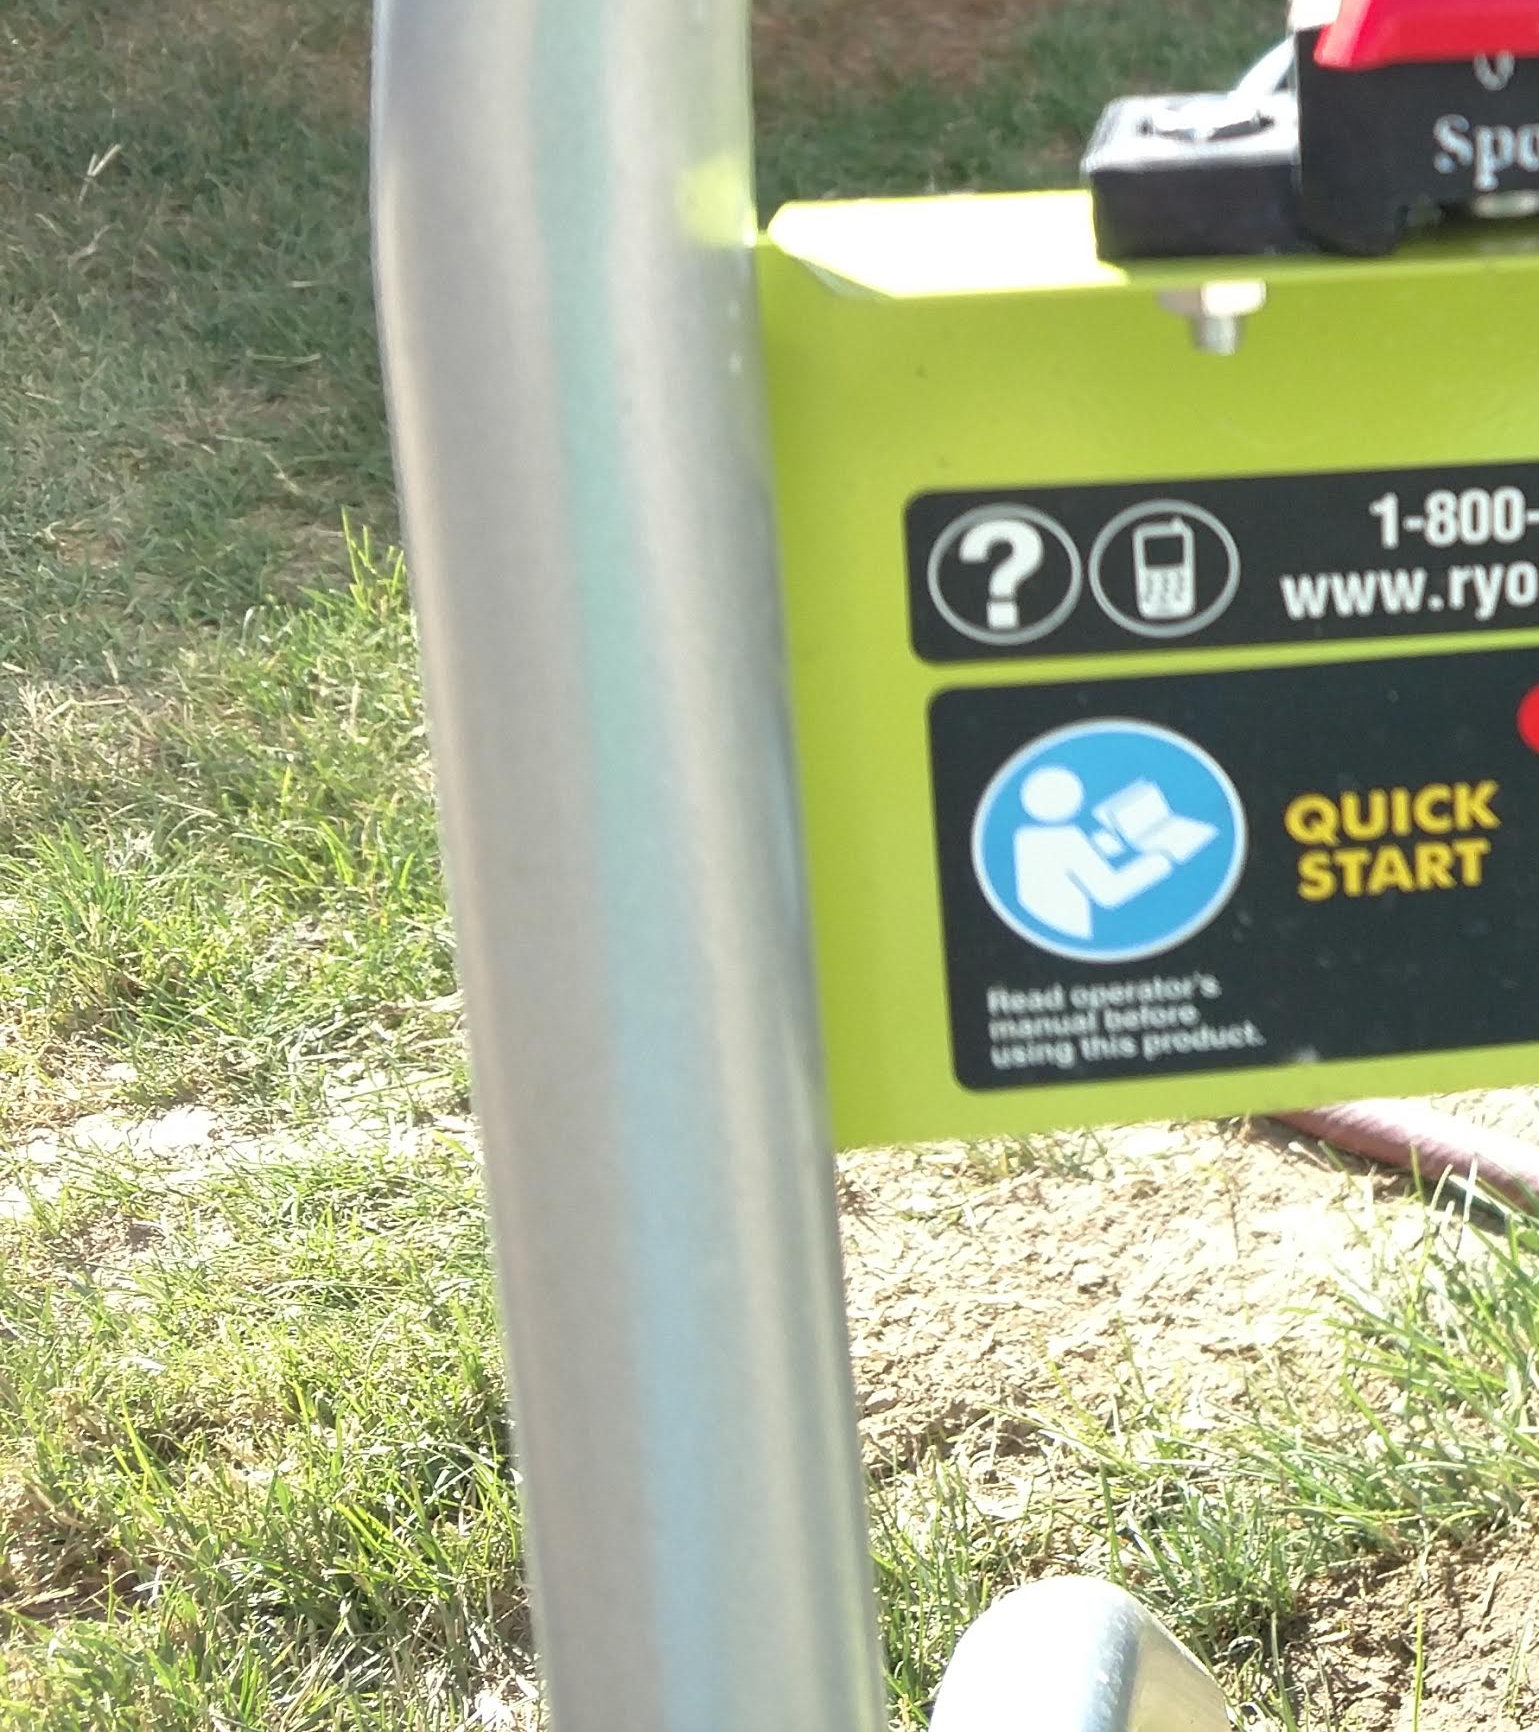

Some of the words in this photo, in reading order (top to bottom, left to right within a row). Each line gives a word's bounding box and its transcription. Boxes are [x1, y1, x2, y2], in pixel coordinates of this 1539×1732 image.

[1284, 781, 1500, 846] QUICK
[1298, 841, 1491, 903] START
[988, 1009, 1097, 1042] manual
[1103, 1003, 1201, 1033] before
[990, 1040, 1077, 1069] using
[1078, 1034, 1138, 1061] this
